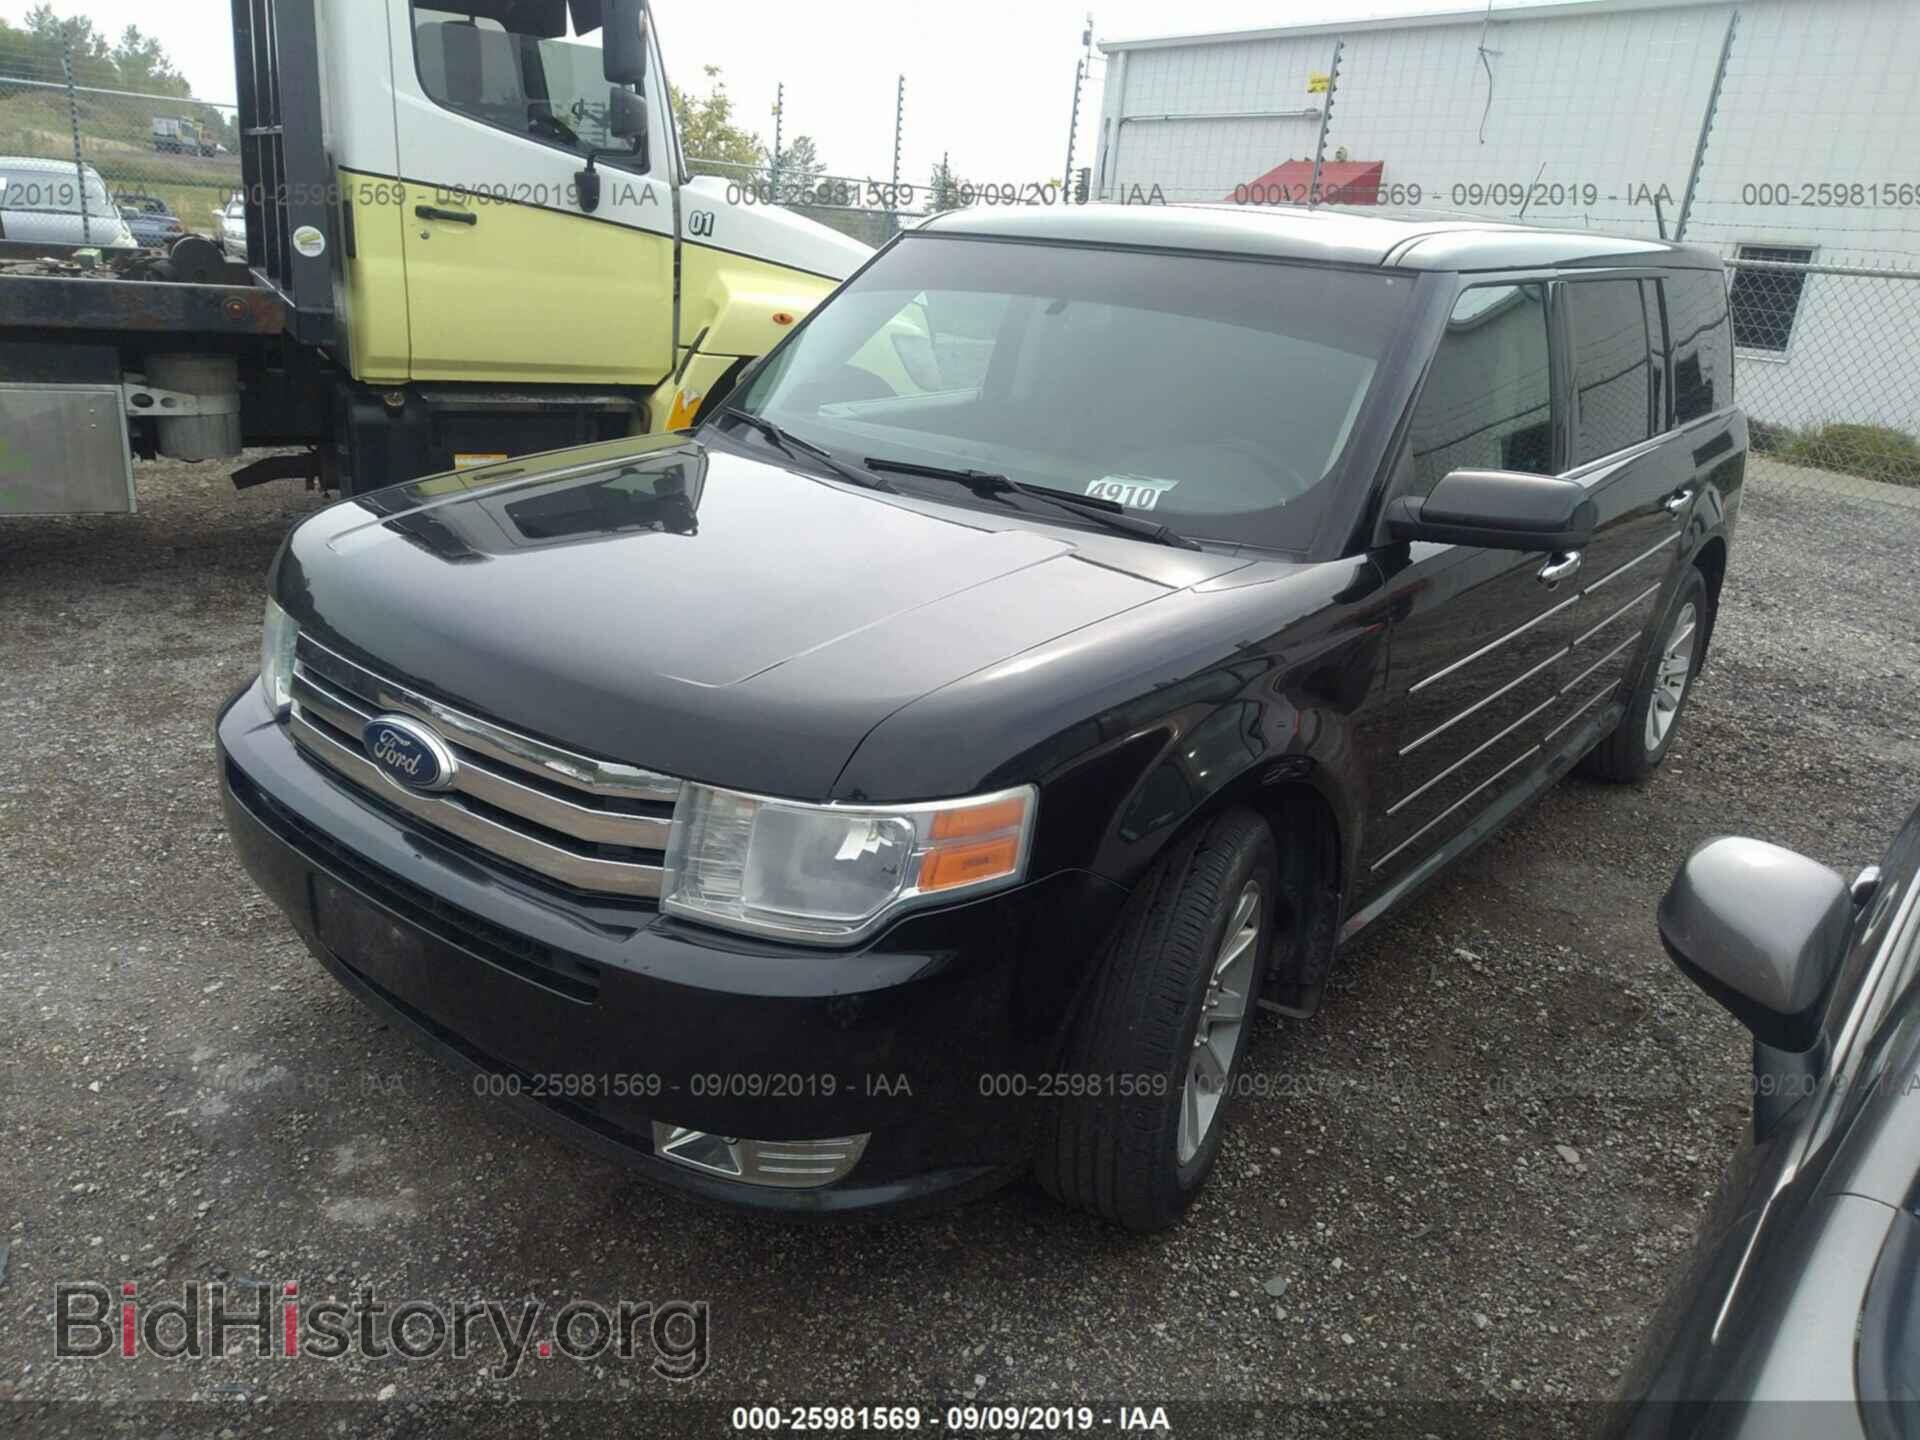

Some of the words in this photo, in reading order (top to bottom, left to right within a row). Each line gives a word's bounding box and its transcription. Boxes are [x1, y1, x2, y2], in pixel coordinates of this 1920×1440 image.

[688, 210, 715, 237] 01
[1087, 482, 1157, 508] 4910
[374, 729, 422, 775] Ford
